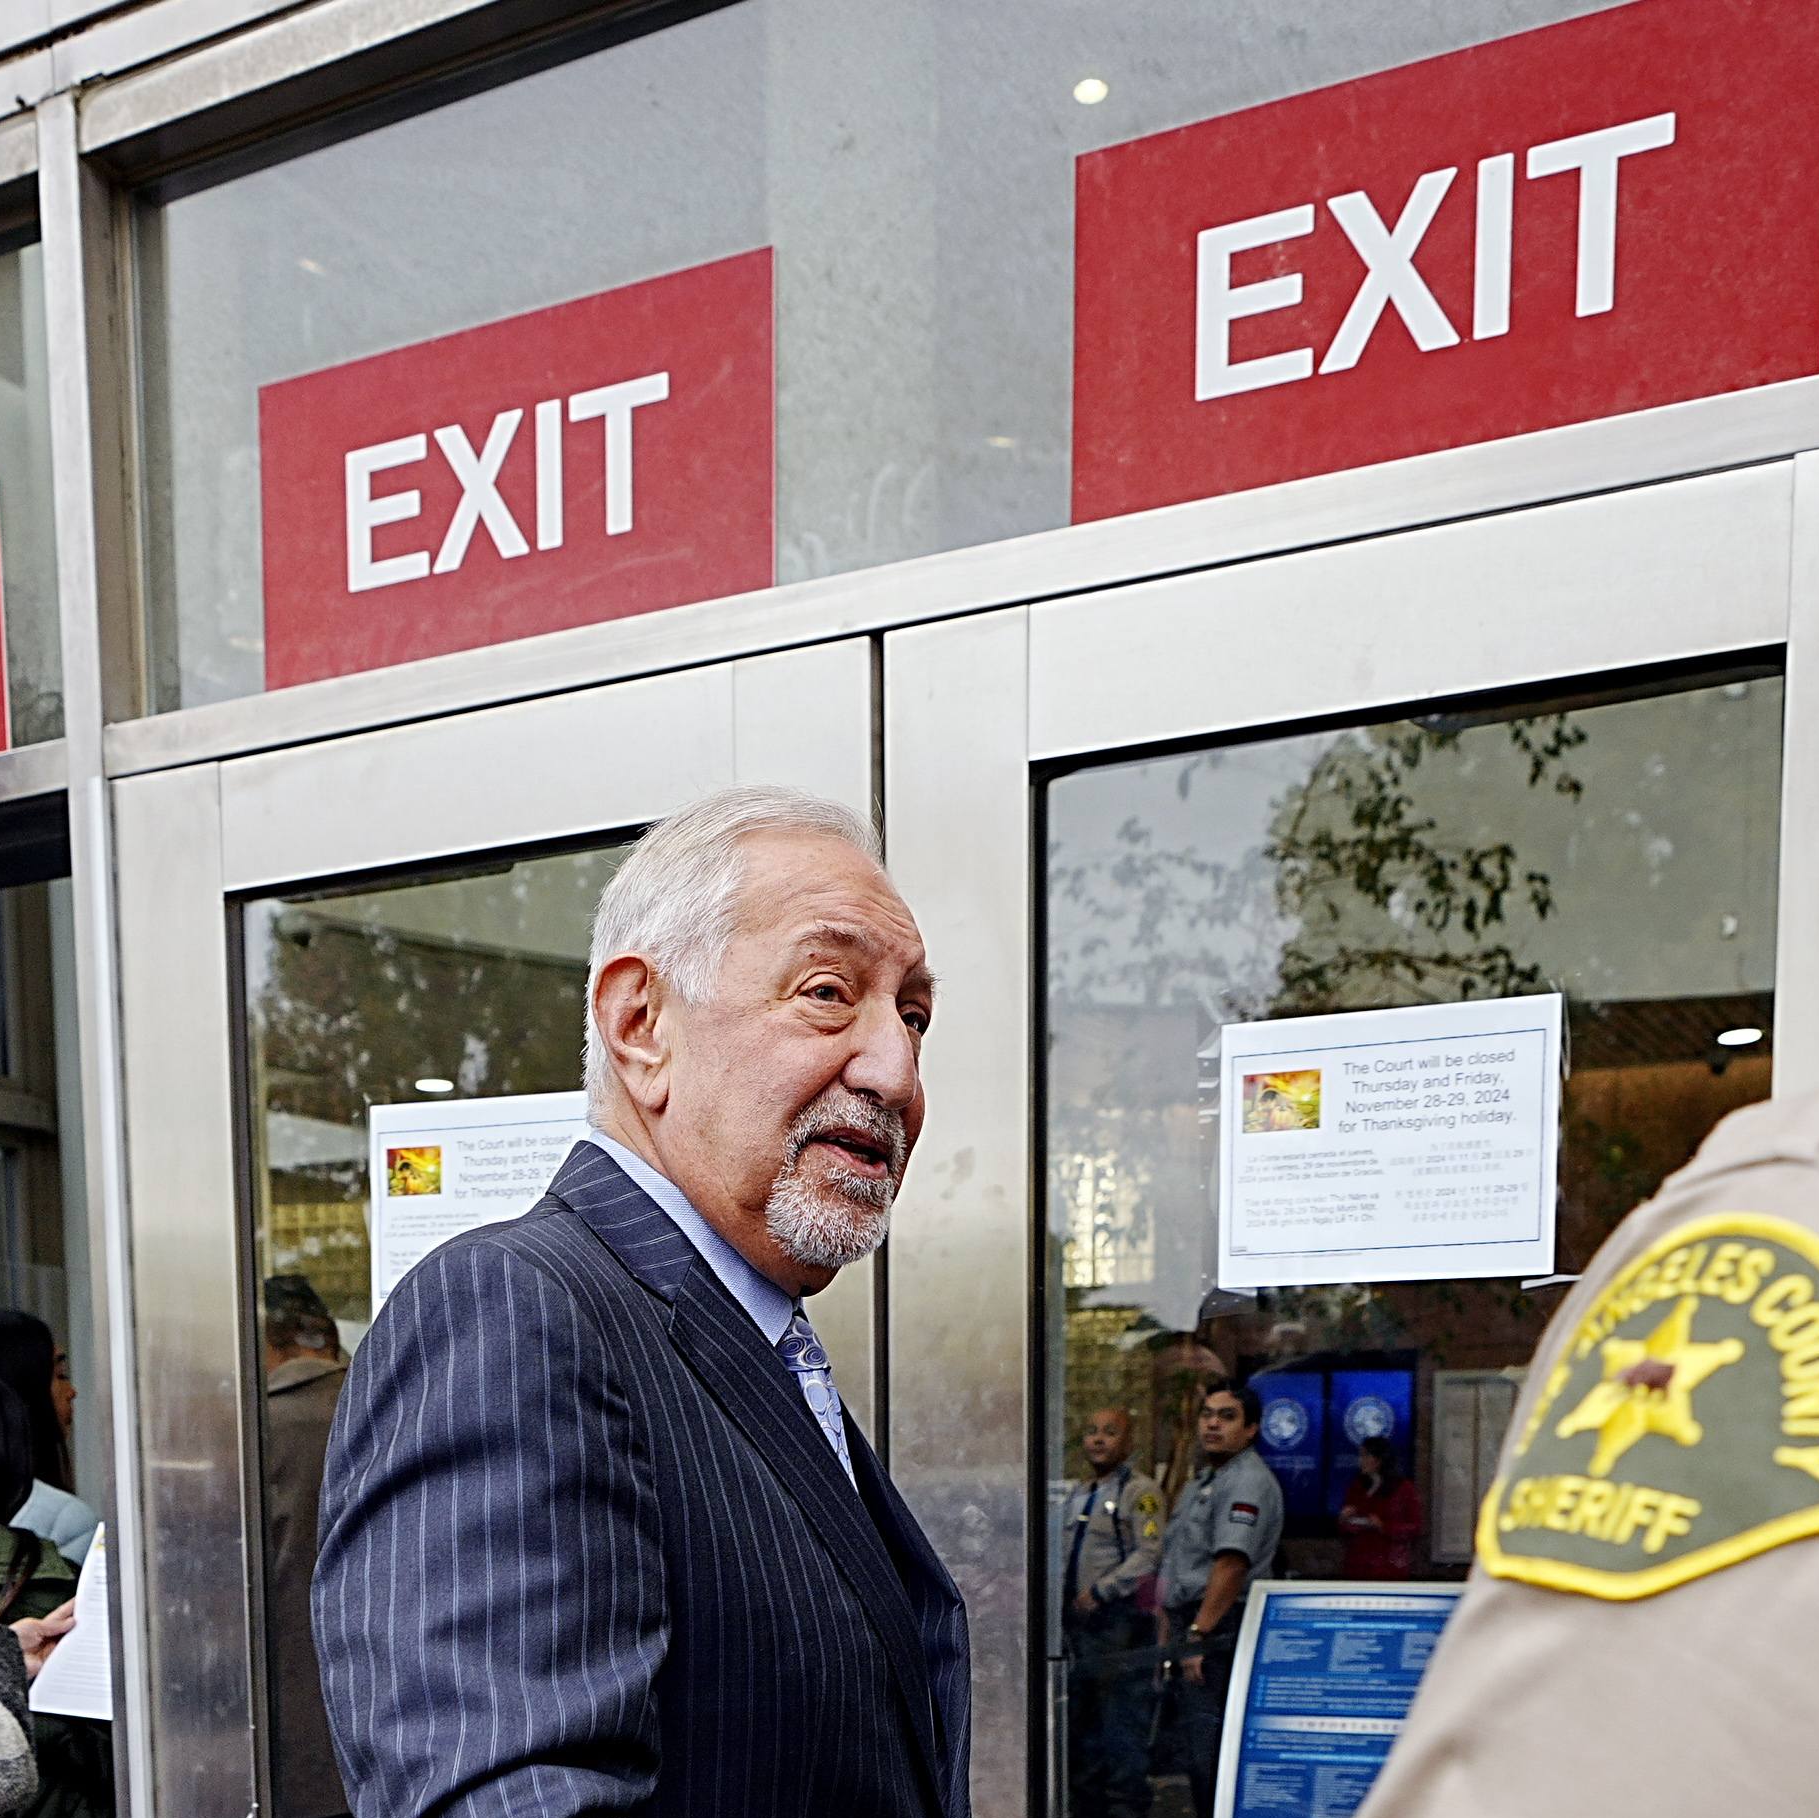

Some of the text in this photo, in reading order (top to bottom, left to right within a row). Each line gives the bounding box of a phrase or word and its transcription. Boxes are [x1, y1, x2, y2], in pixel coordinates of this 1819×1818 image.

[1194, 112, 1676, 402] EXIT
[344, 371, 670, 594] EXIT
[1342, 1049, 1515, 1075] The Court will be closed
[1352, 1078, 1418, 1094] Thursday
[1423, 1074, 1450, 1089] and
[1345, 1097, 1419, 1113] November
[1474, 1089, 1510, 1104] 2024
[1338, 1109, 1517, 1133] for Thanksgiving holiday.
[456, 1141, 475, 1151] The
[478, 1140, 504, 1150] Court
[525, 1136, 536, 1146] be
[541, 1134, 573, 1146] closed
[464, 1156, 508, 1167] Thursday
[511, 1154, 529, 1164] and
[459, 1172, 509, 1182] November
[454, 1188, 466, 1198] for
[471, 1186, 535, 1199] Thanksgiving
[1498, 1475, 1702, 1555] SHERIFF
